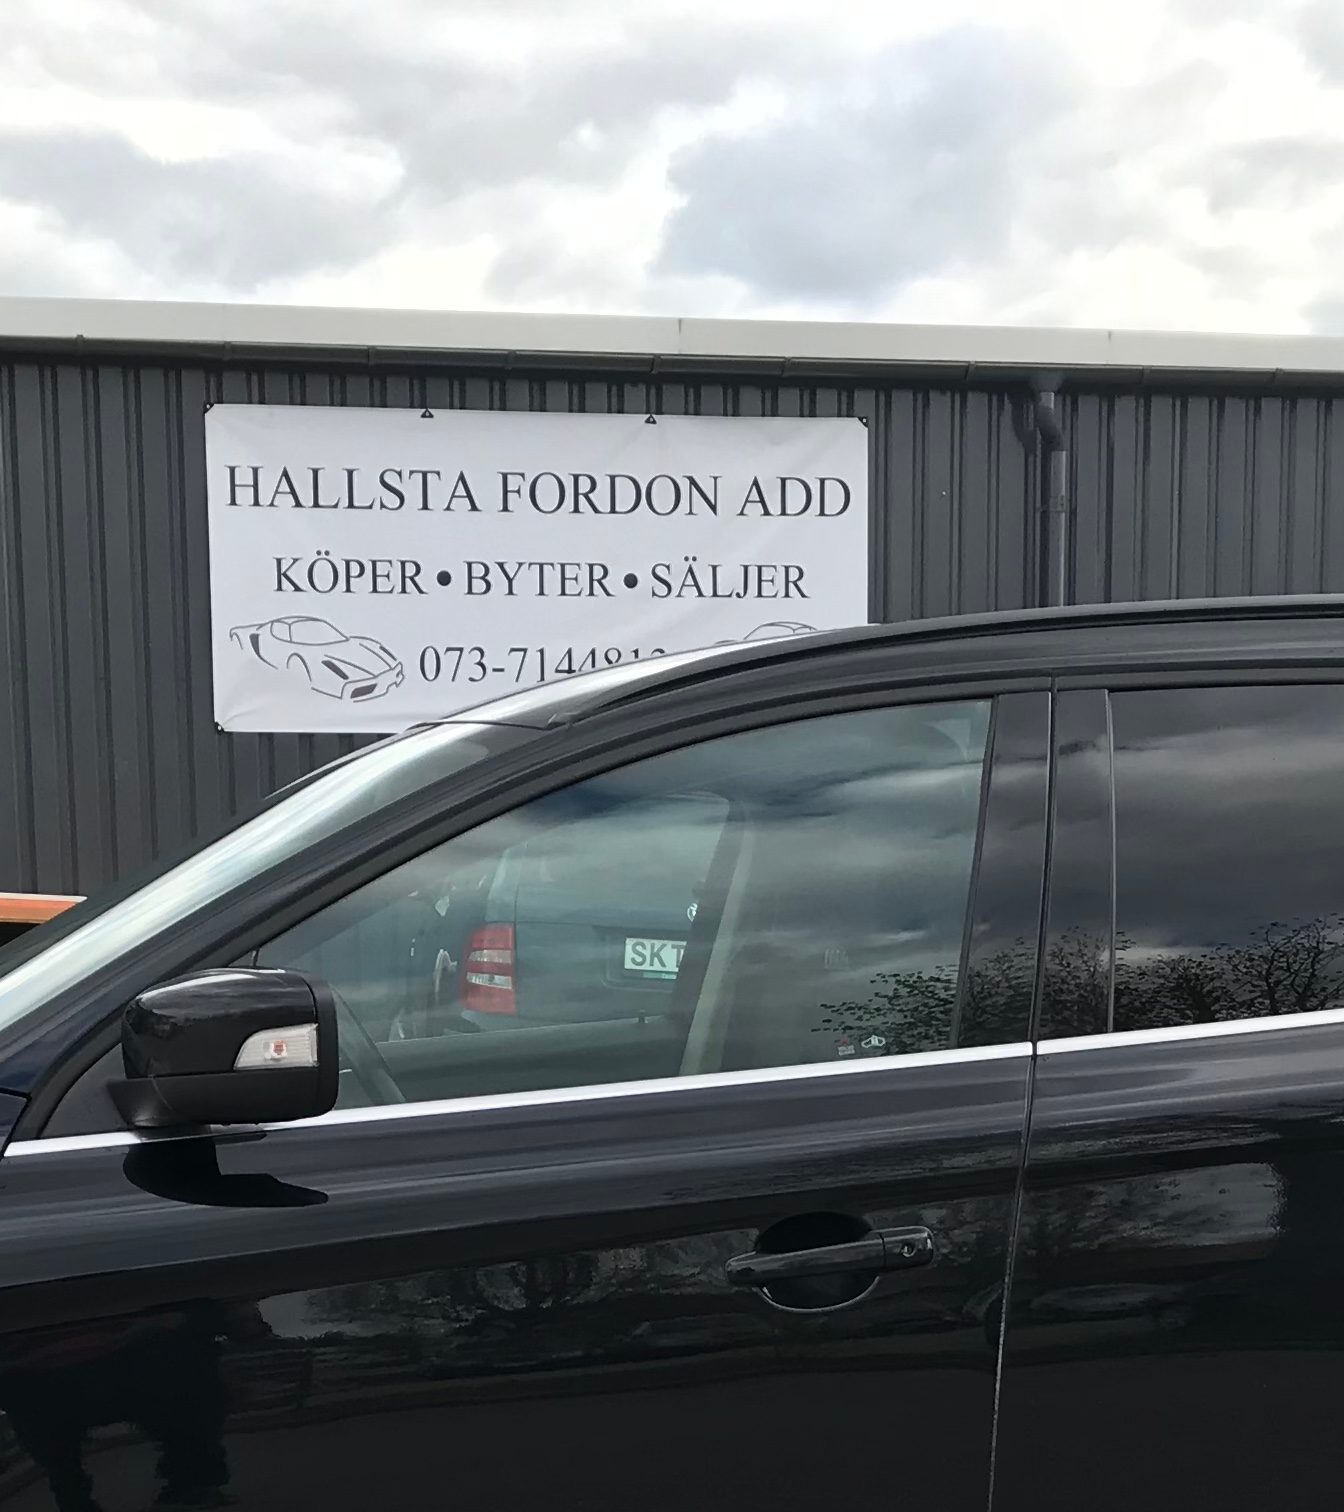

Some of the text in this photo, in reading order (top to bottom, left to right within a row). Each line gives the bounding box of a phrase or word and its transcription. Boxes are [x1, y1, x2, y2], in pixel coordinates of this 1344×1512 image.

[226, 465, 851, 517] HALLSTA FORDON ADD
[275, 549, 810, 599] KÖPER BYTER SÄLJER
